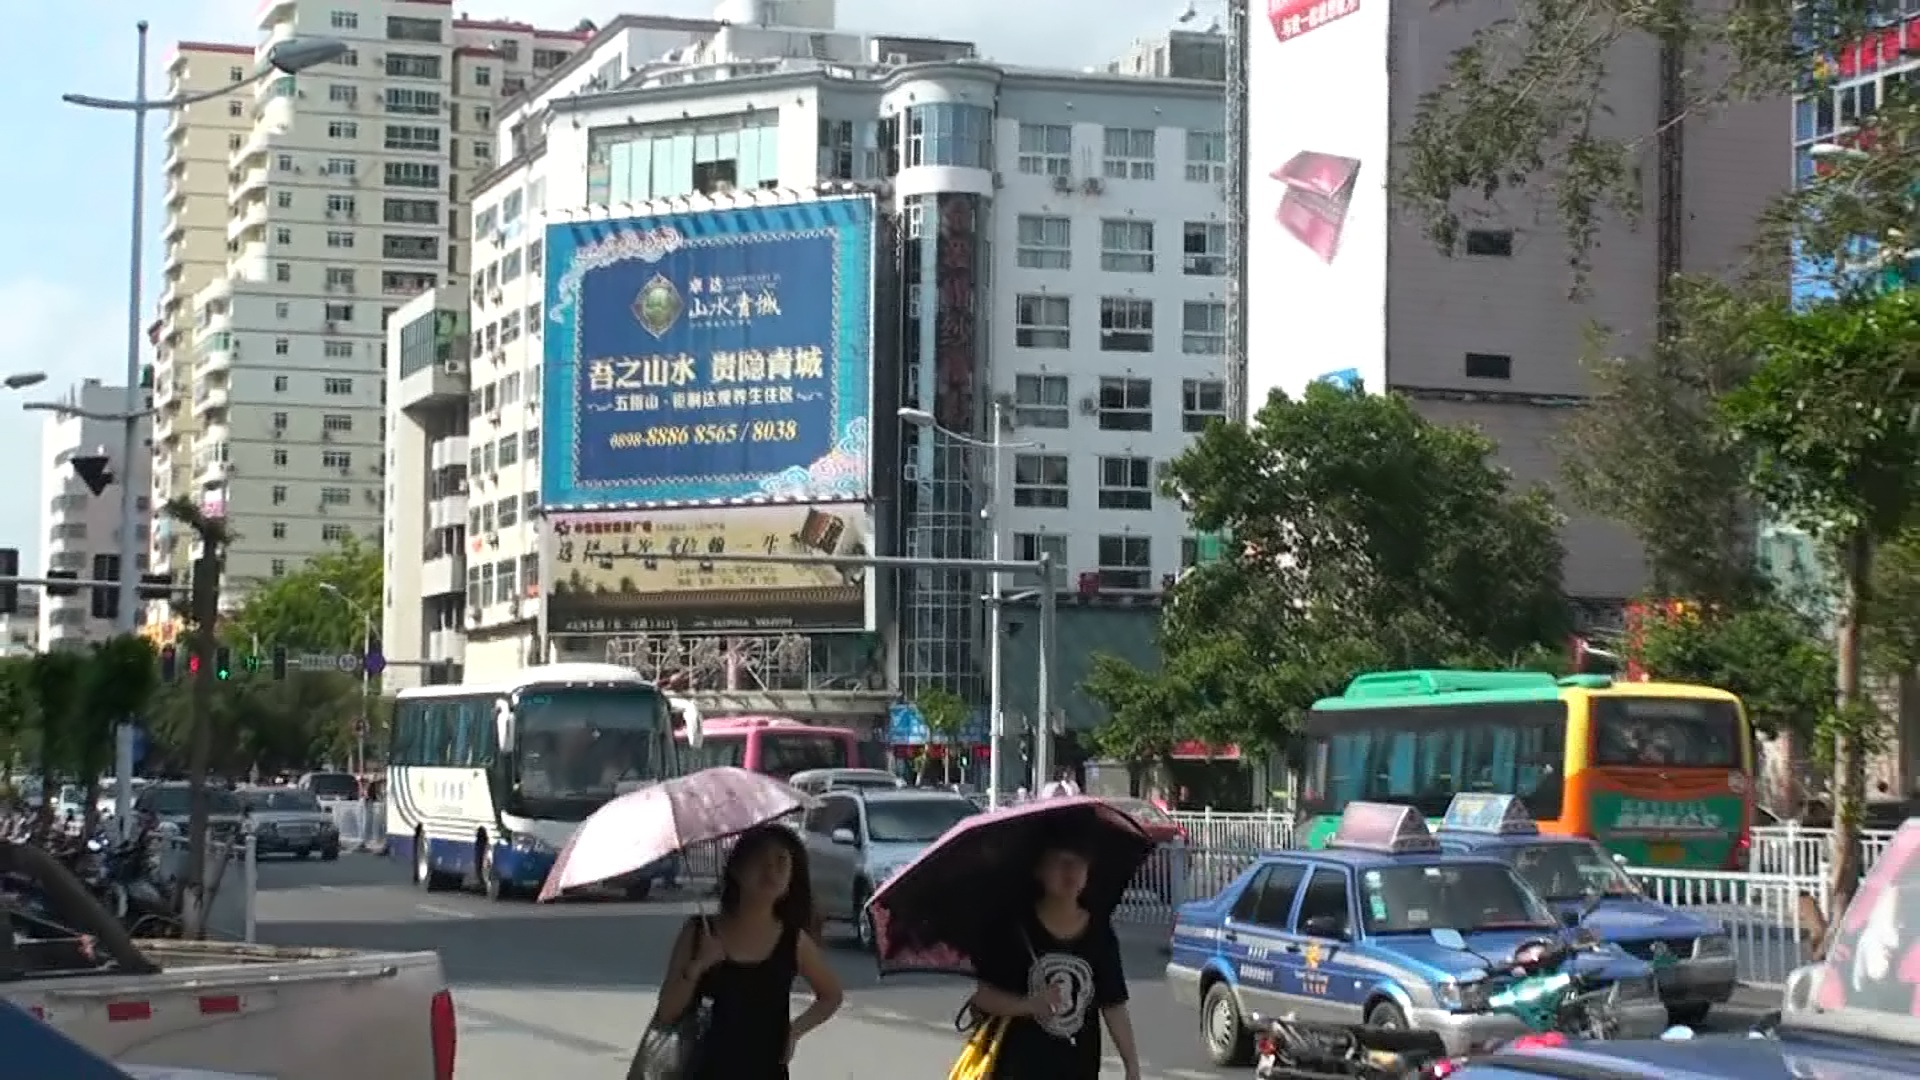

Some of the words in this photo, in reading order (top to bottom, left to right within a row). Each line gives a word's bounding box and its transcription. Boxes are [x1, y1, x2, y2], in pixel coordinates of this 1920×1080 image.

[589, 352, 697, 391] 吾之山水
[693, 422, 738, 444] 8565
[751, 418, 799, 443] 8038
